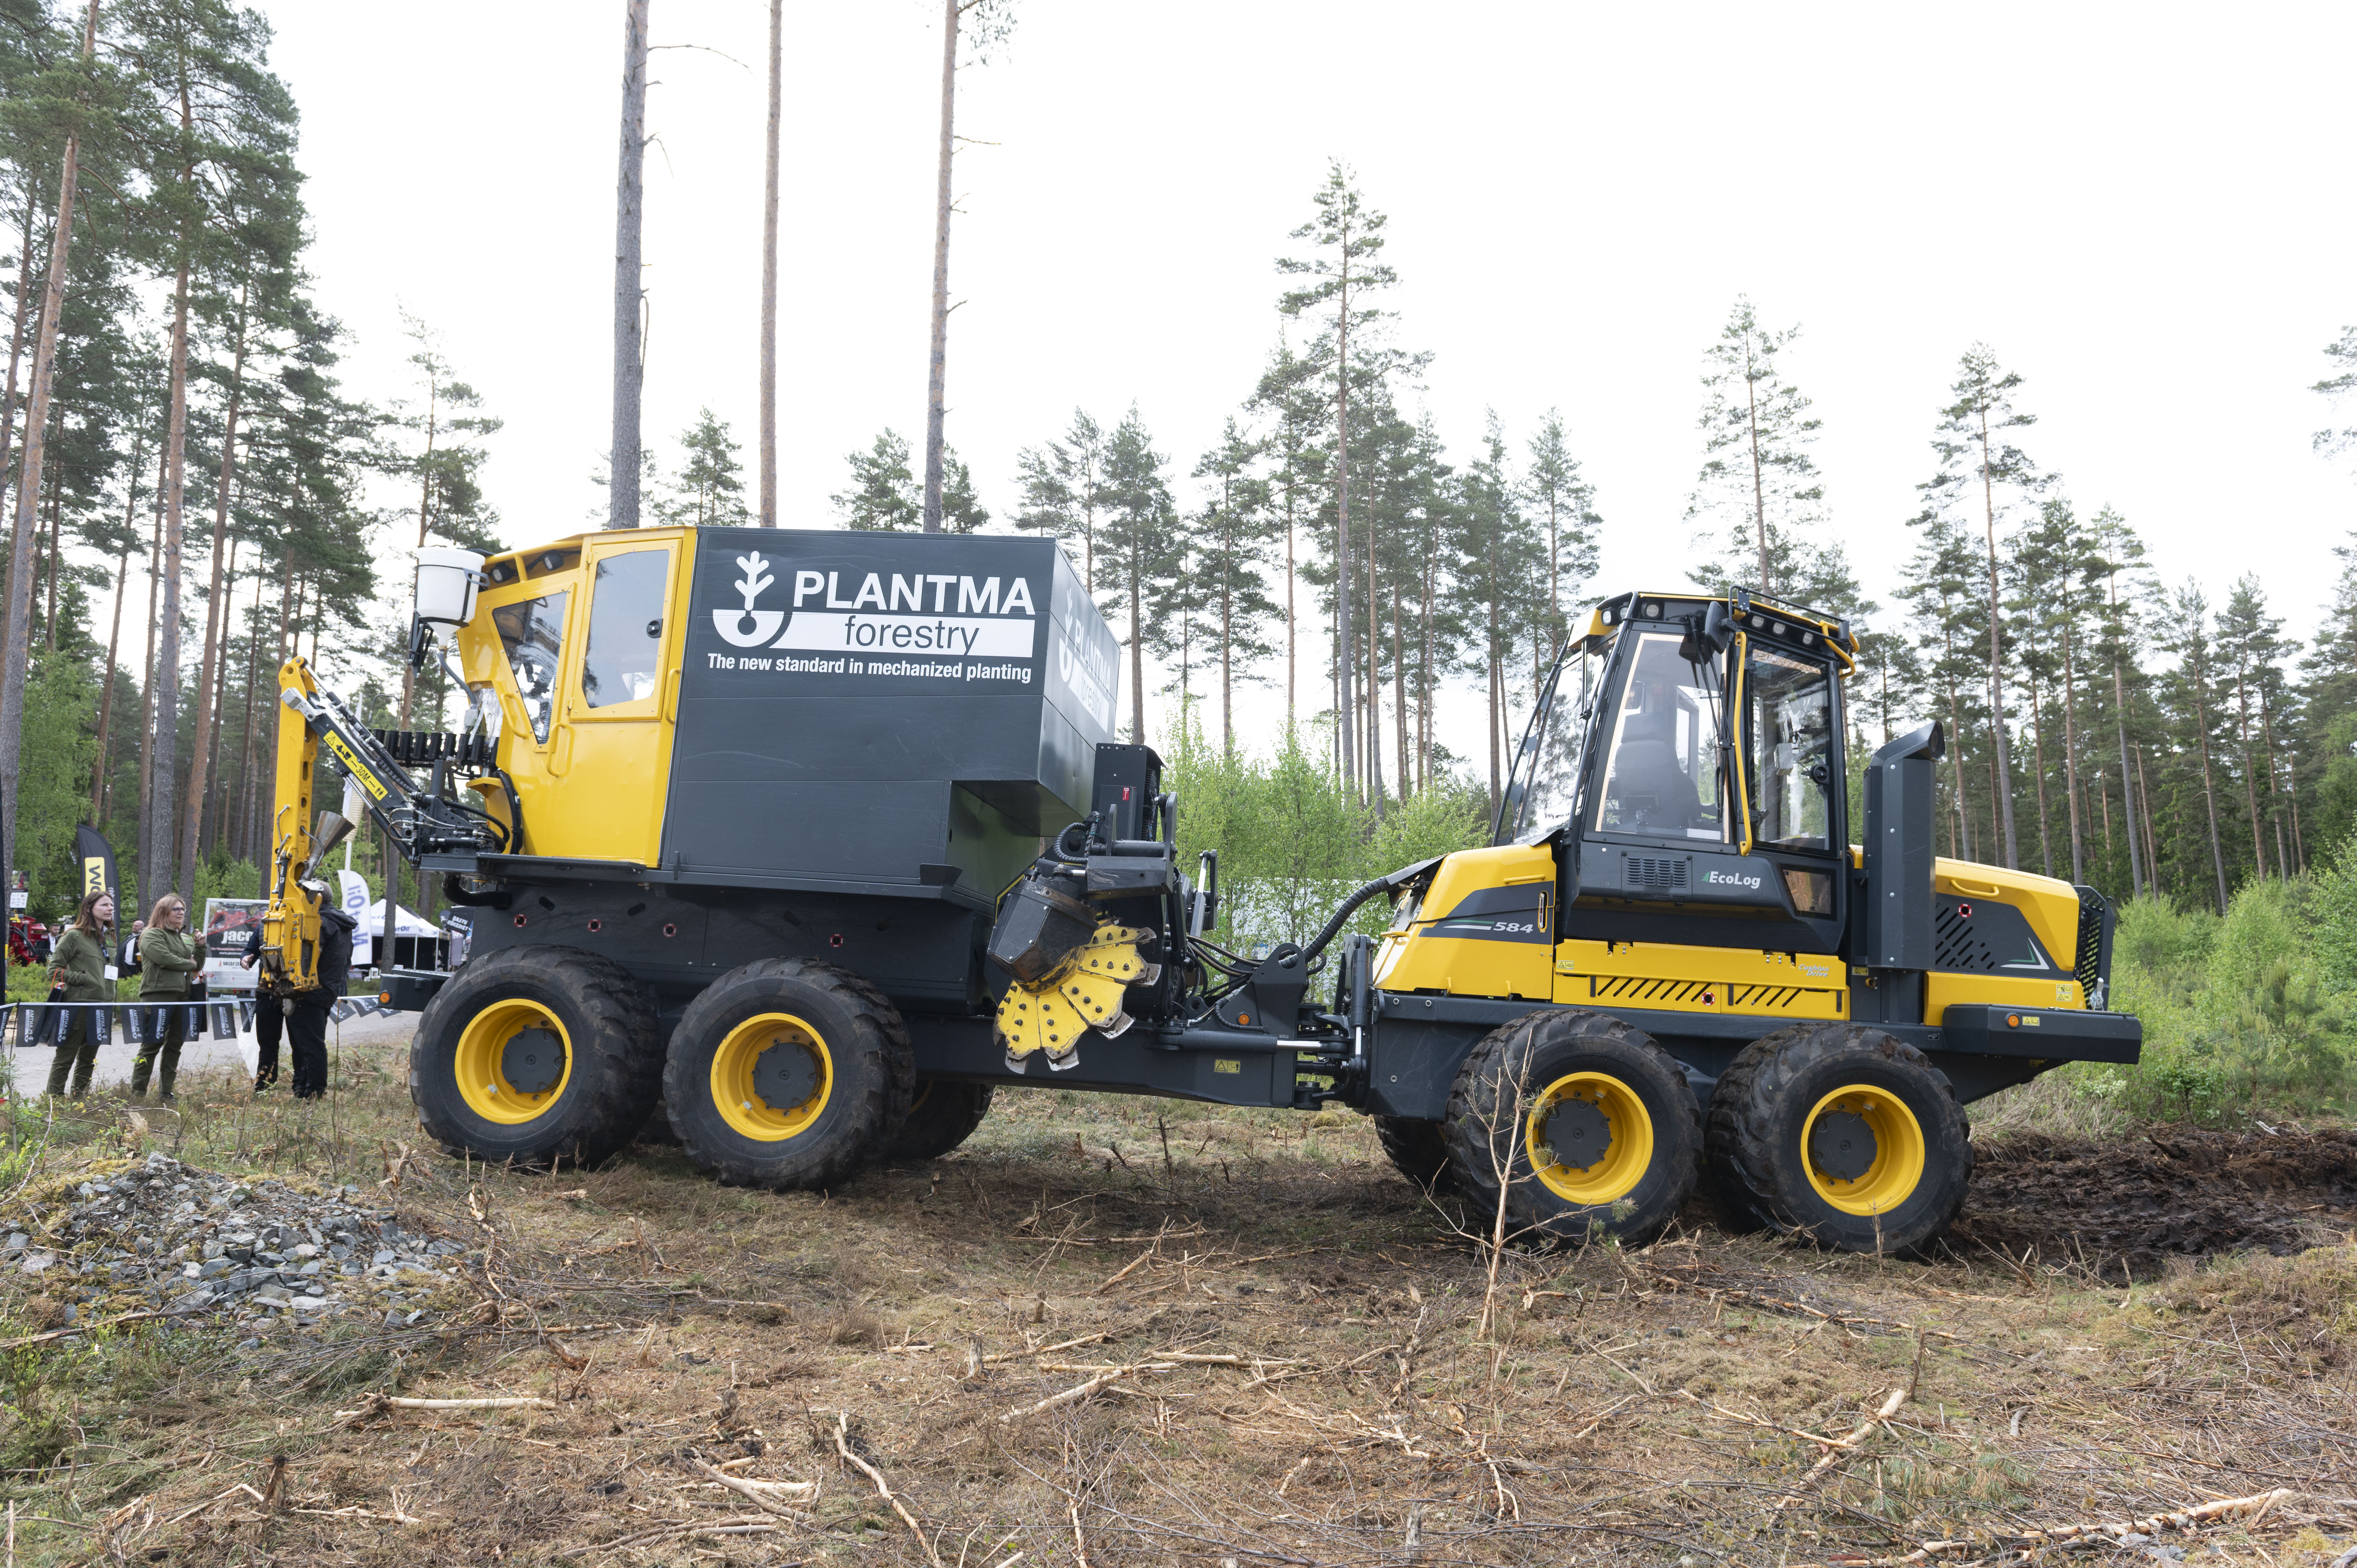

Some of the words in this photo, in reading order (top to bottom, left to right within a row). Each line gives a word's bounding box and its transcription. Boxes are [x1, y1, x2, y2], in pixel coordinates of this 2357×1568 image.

[793, 570, 1035, 615] PLANTMA
[845, 615, 980, 655] forestry
[708, 653, 735, 669] The
[739, 657, 772, 670] new
[776, 656, 845, 674] standard
[849, 658, 863, 674] in
[868, 660, 962, 678] mechanized
[966, 663, 1032, 684] planting
[1074, 618, 1110, 698] PLANTMA
[1081, 670, 1102, 722] forestry
[1709, 871, 1761, 889] EcoLog
[1493, 922, 1533, 933] 584
[1799, 964, 1829, 972] Cushion
